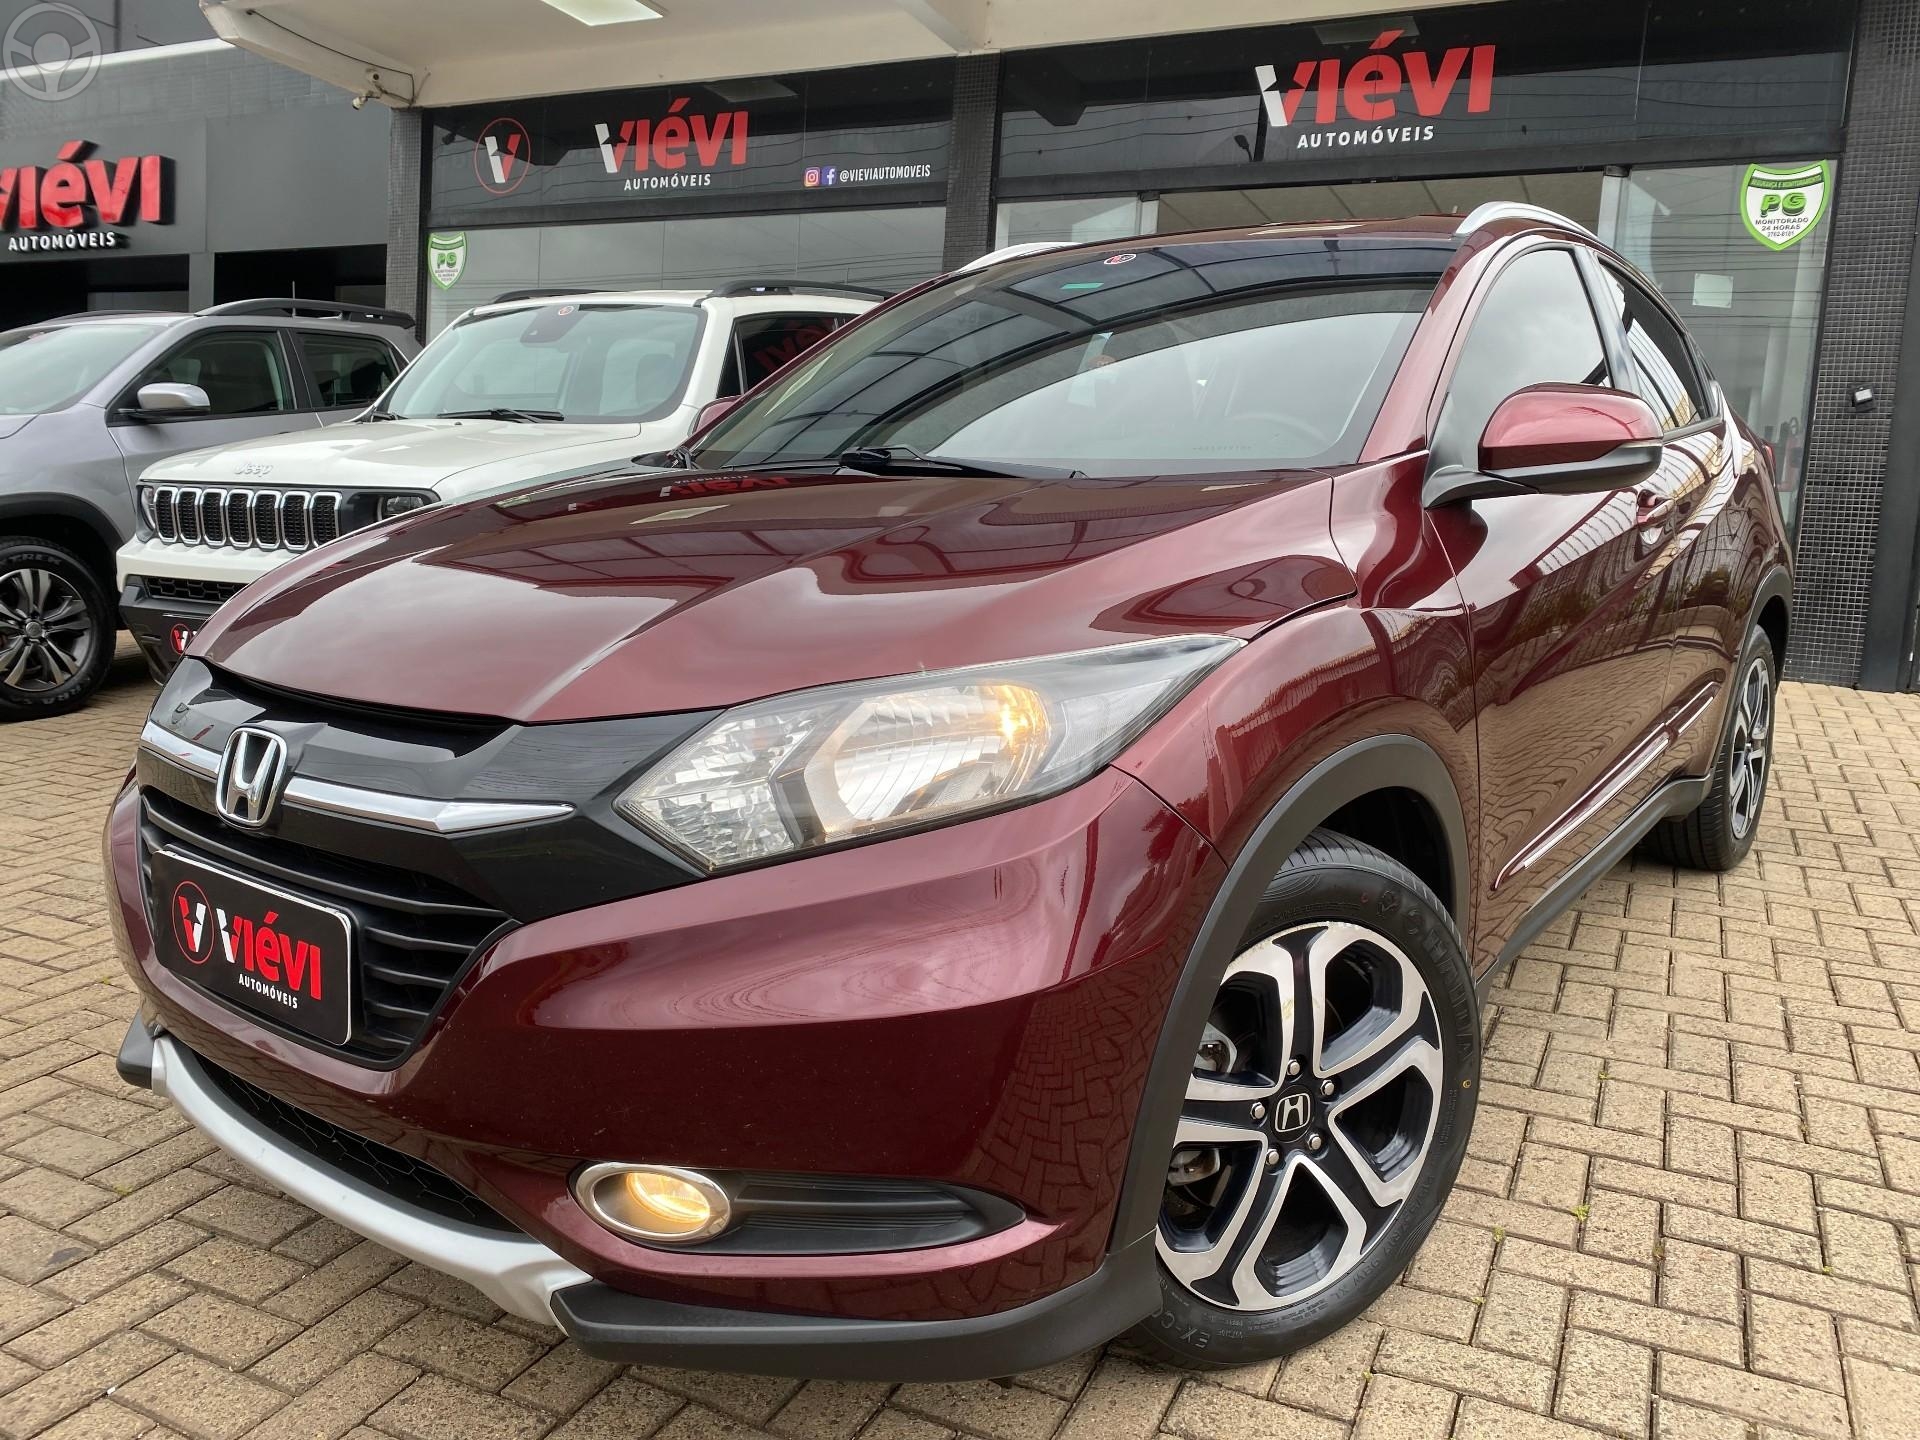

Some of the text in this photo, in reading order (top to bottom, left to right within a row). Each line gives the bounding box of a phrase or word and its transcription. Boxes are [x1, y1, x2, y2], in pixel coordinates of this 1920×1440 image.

[1297, 125, 1435, 149] AUTOMÓVEIS
[624, 172, 711, 191] AUTOMÓVEIS
[840, 164, 931, 182] @VIEVIAUTOMOVEIS
[1755, 217, 1808, 225] MONITORADO
[1773, 223, 1801, 232] HORAS
[8, 229, 117, 251] AUTOMÓVEIS
[234, 462, 274, 478] Jeep
[238, 973, 299, 1009] AUTOMÓVEIS
